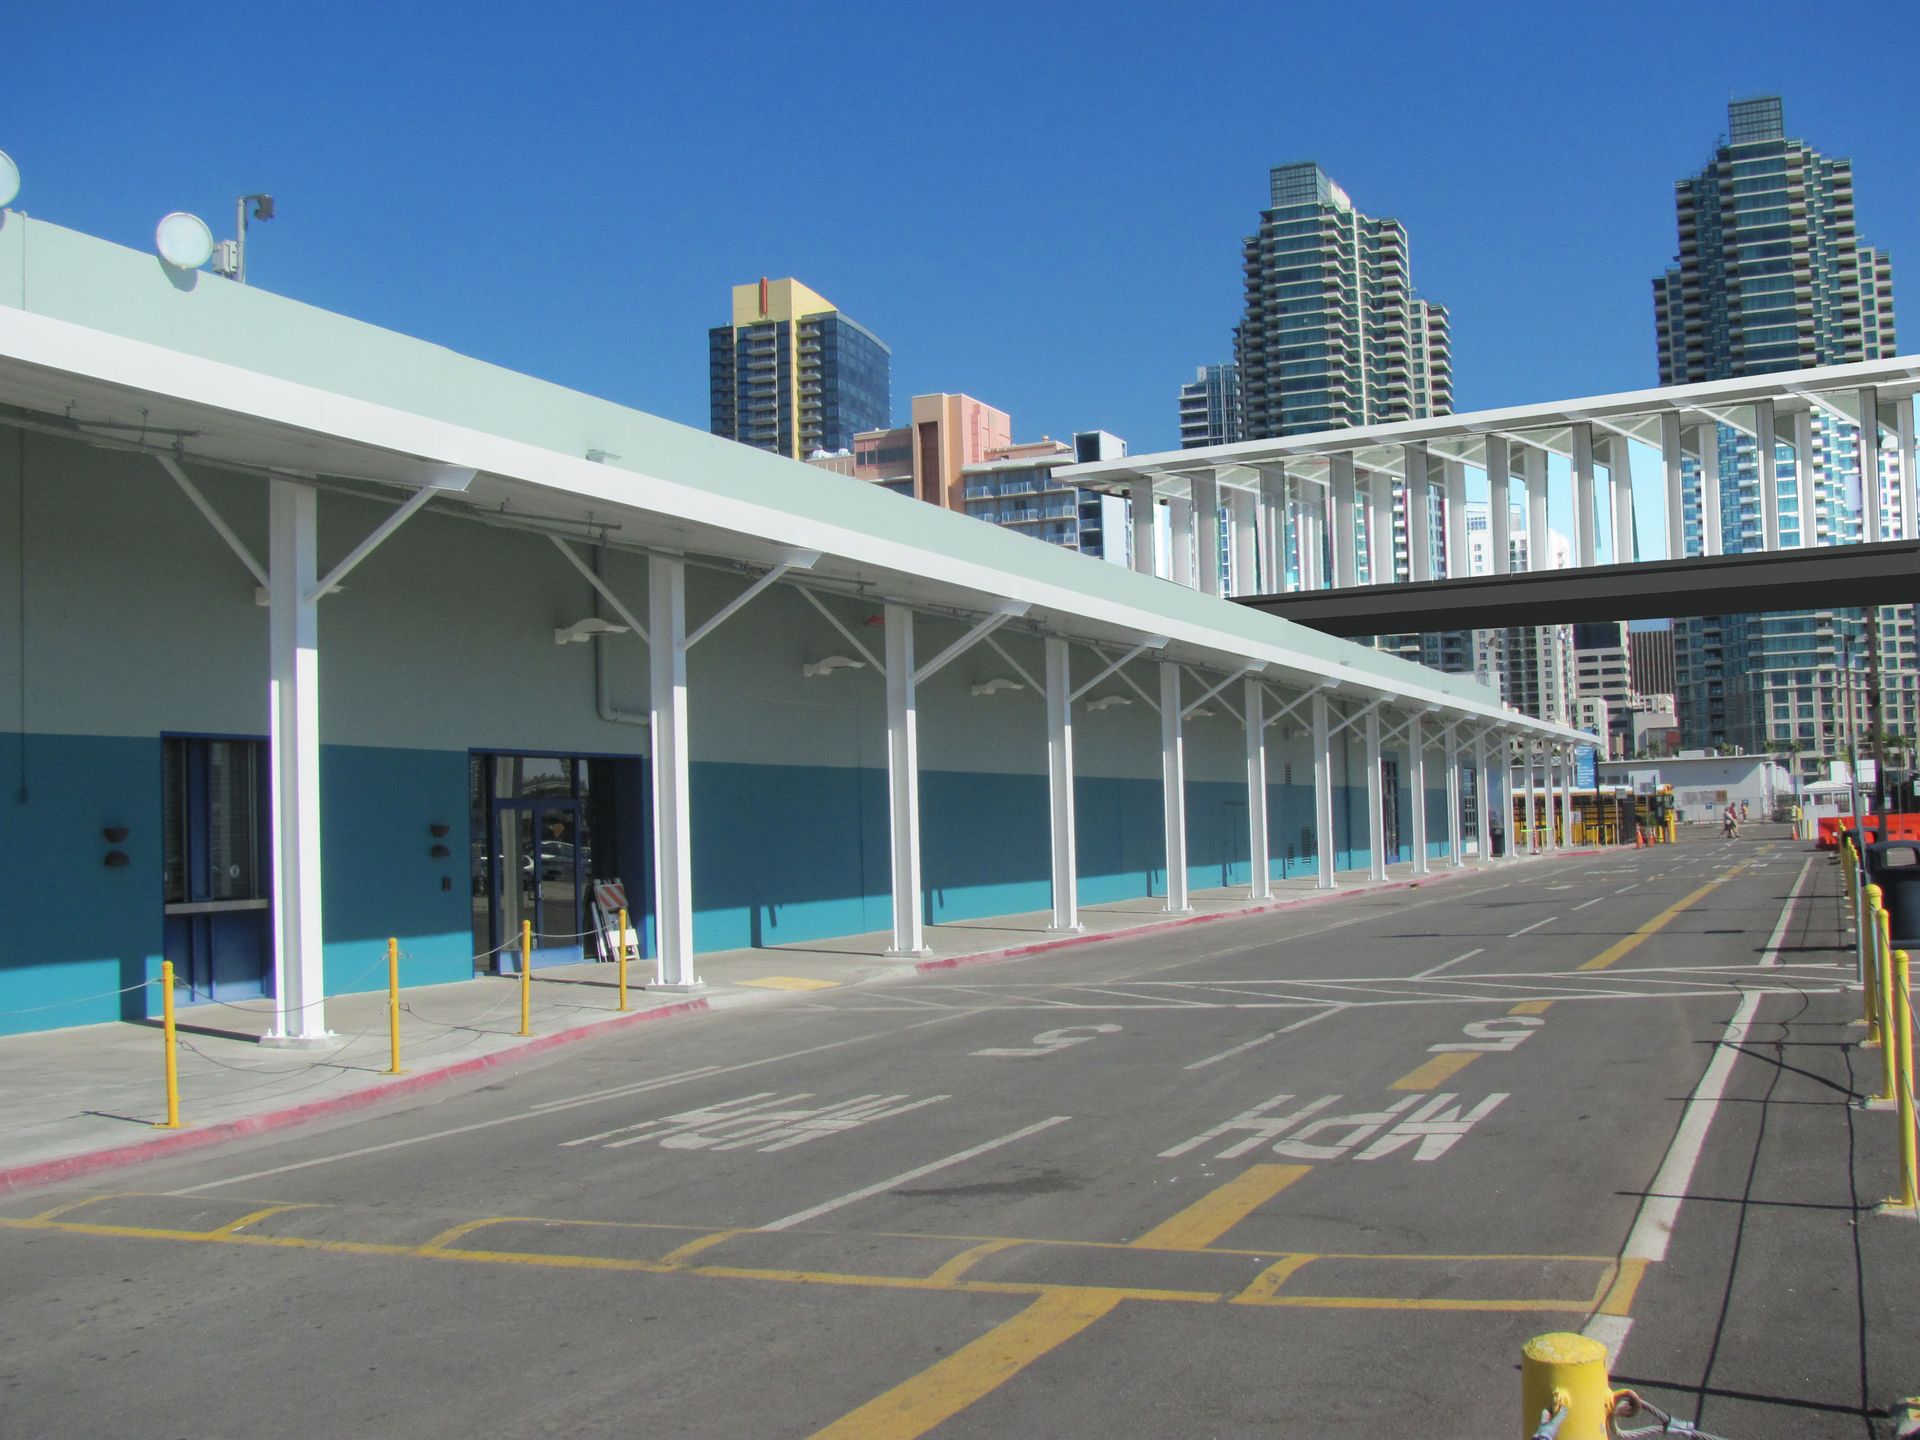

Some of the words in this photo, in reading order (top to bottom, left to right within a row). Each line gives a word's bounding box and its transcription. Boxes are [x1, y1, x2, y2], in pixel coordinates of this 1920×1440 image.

[1426, 1016, 1545, 1052] 5
[557, 1092, 953, 1152] MPH
[1155, 1092, 1512, 1161] MPH
